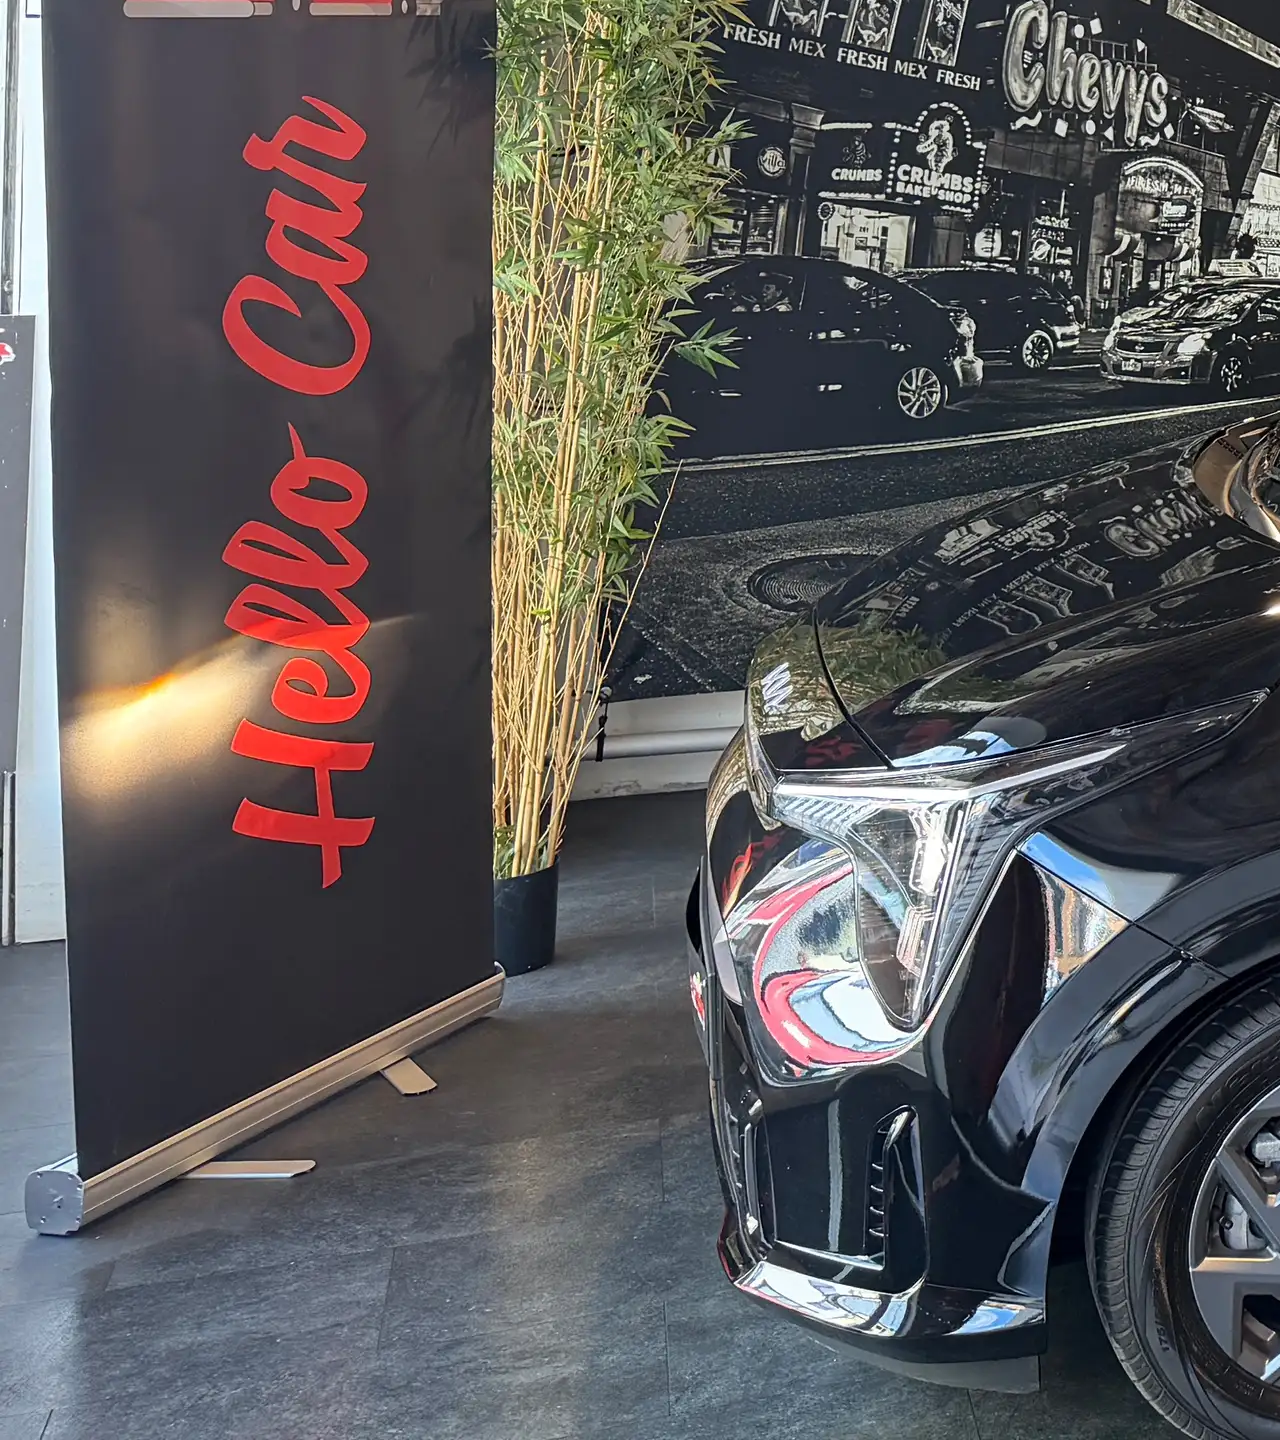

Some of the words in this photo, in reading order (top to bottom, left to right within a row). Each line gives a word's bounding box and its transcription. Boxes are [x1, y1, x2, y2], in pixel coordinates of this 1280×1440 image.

[723, 23, 781, 50] FRESH
[788, 37, 827, 59] MEX
[836, 47, 888, 72] FRESH
[894, 60, 928, 80] MEX
[936, 69, 981, 91] FRESH
[831, 167, 883, 182] CRUMBS
[897, 164, 974, 194] CRUMBS
[937, 189, 972, 204] SHOP
[223, 96, 371, 396] Car
[223, 422, 375, 888] Hello
